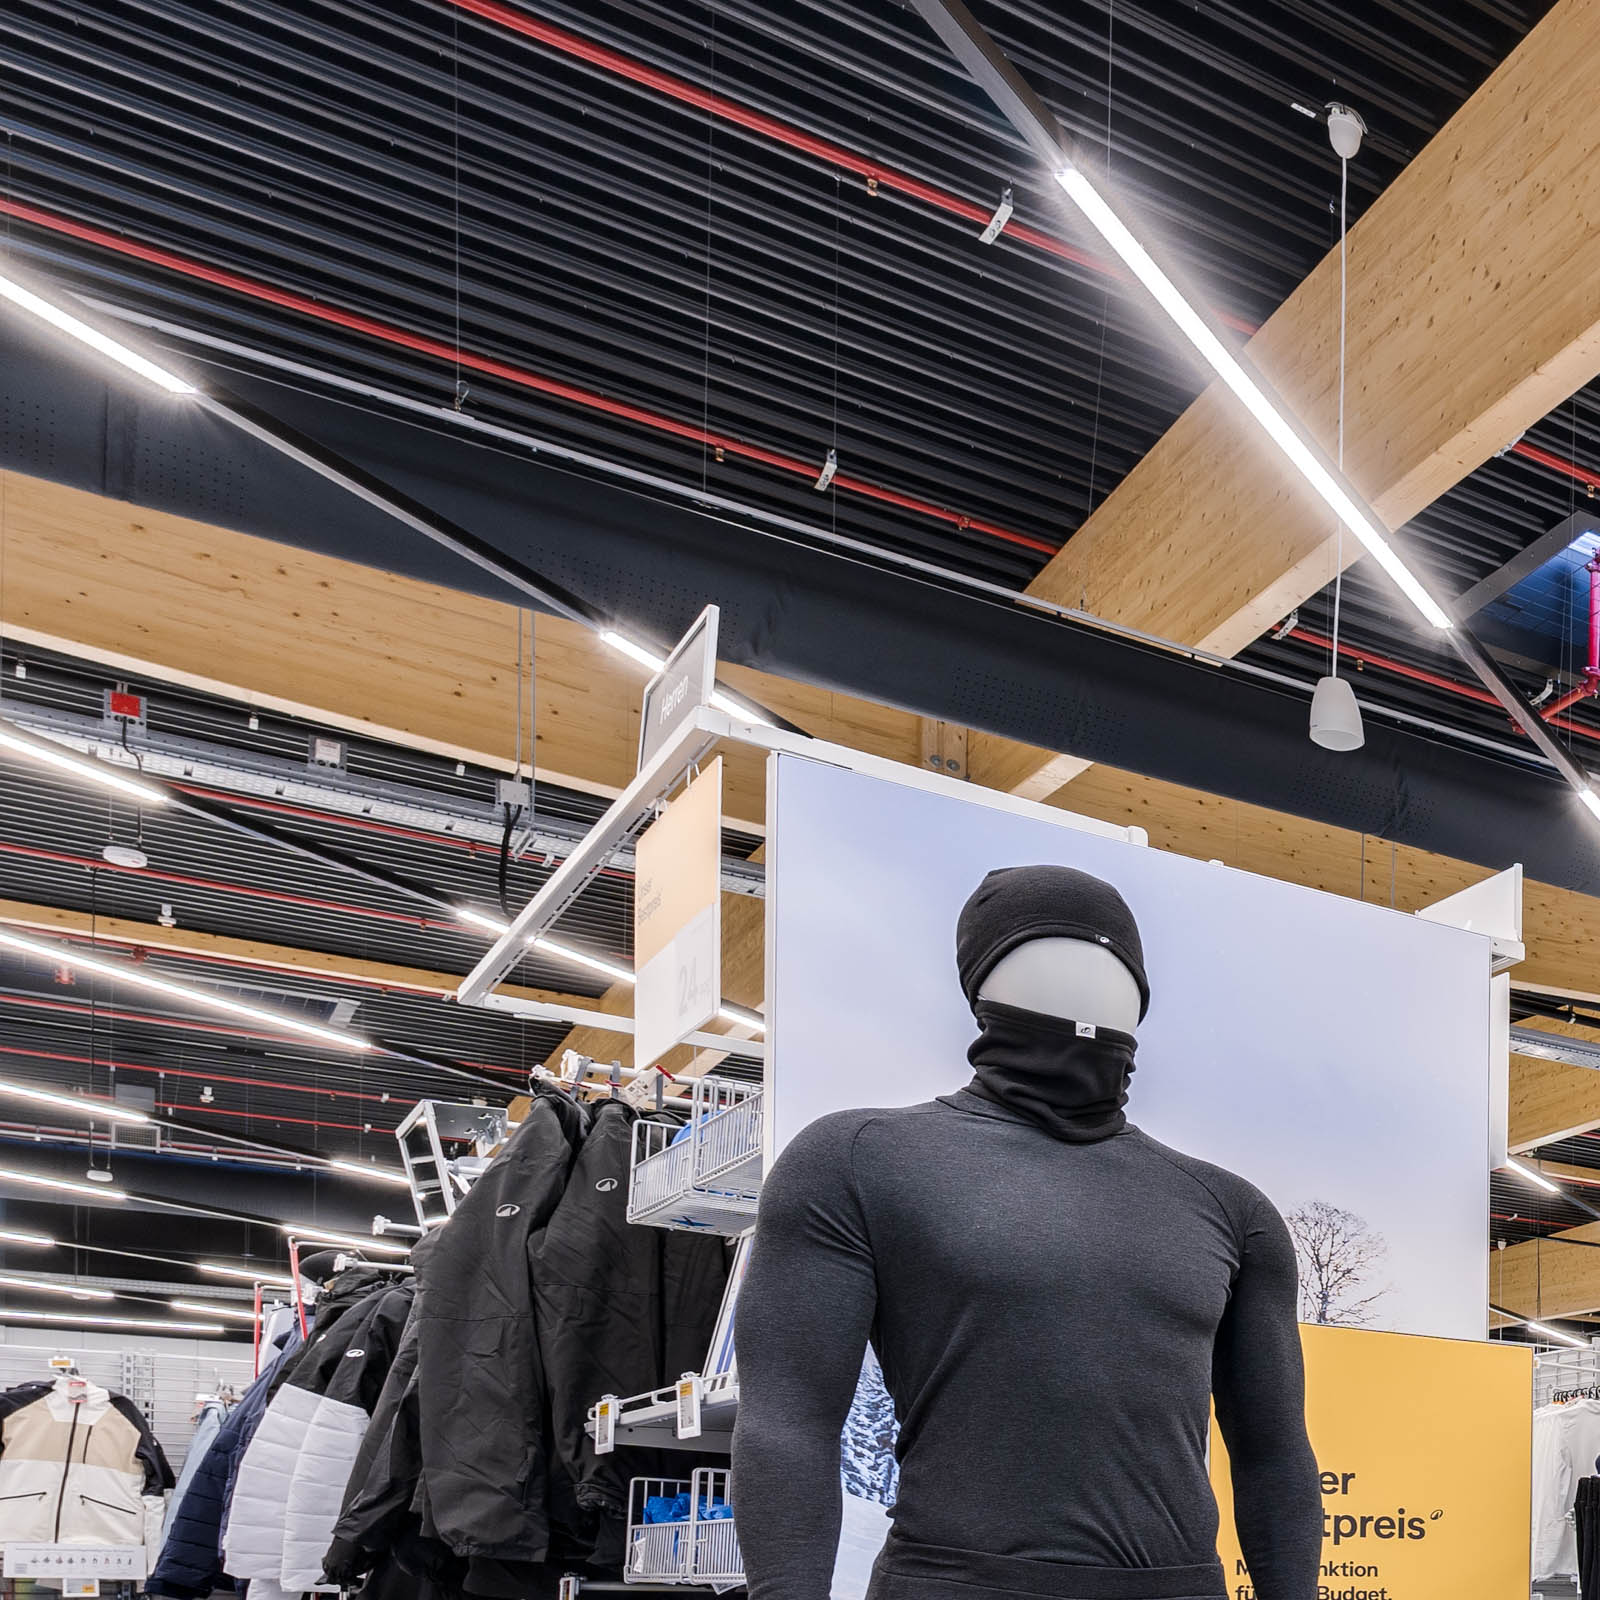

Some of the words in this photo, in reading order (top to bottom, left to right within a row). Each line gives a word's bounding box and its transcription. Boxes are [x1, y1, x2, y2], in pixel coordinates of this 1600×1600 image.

[659, 675, 688, 725] Herren
[1322, 1508, 1426, 1545] tpreis
[1317, 1561, 1378, 1577] nktion
